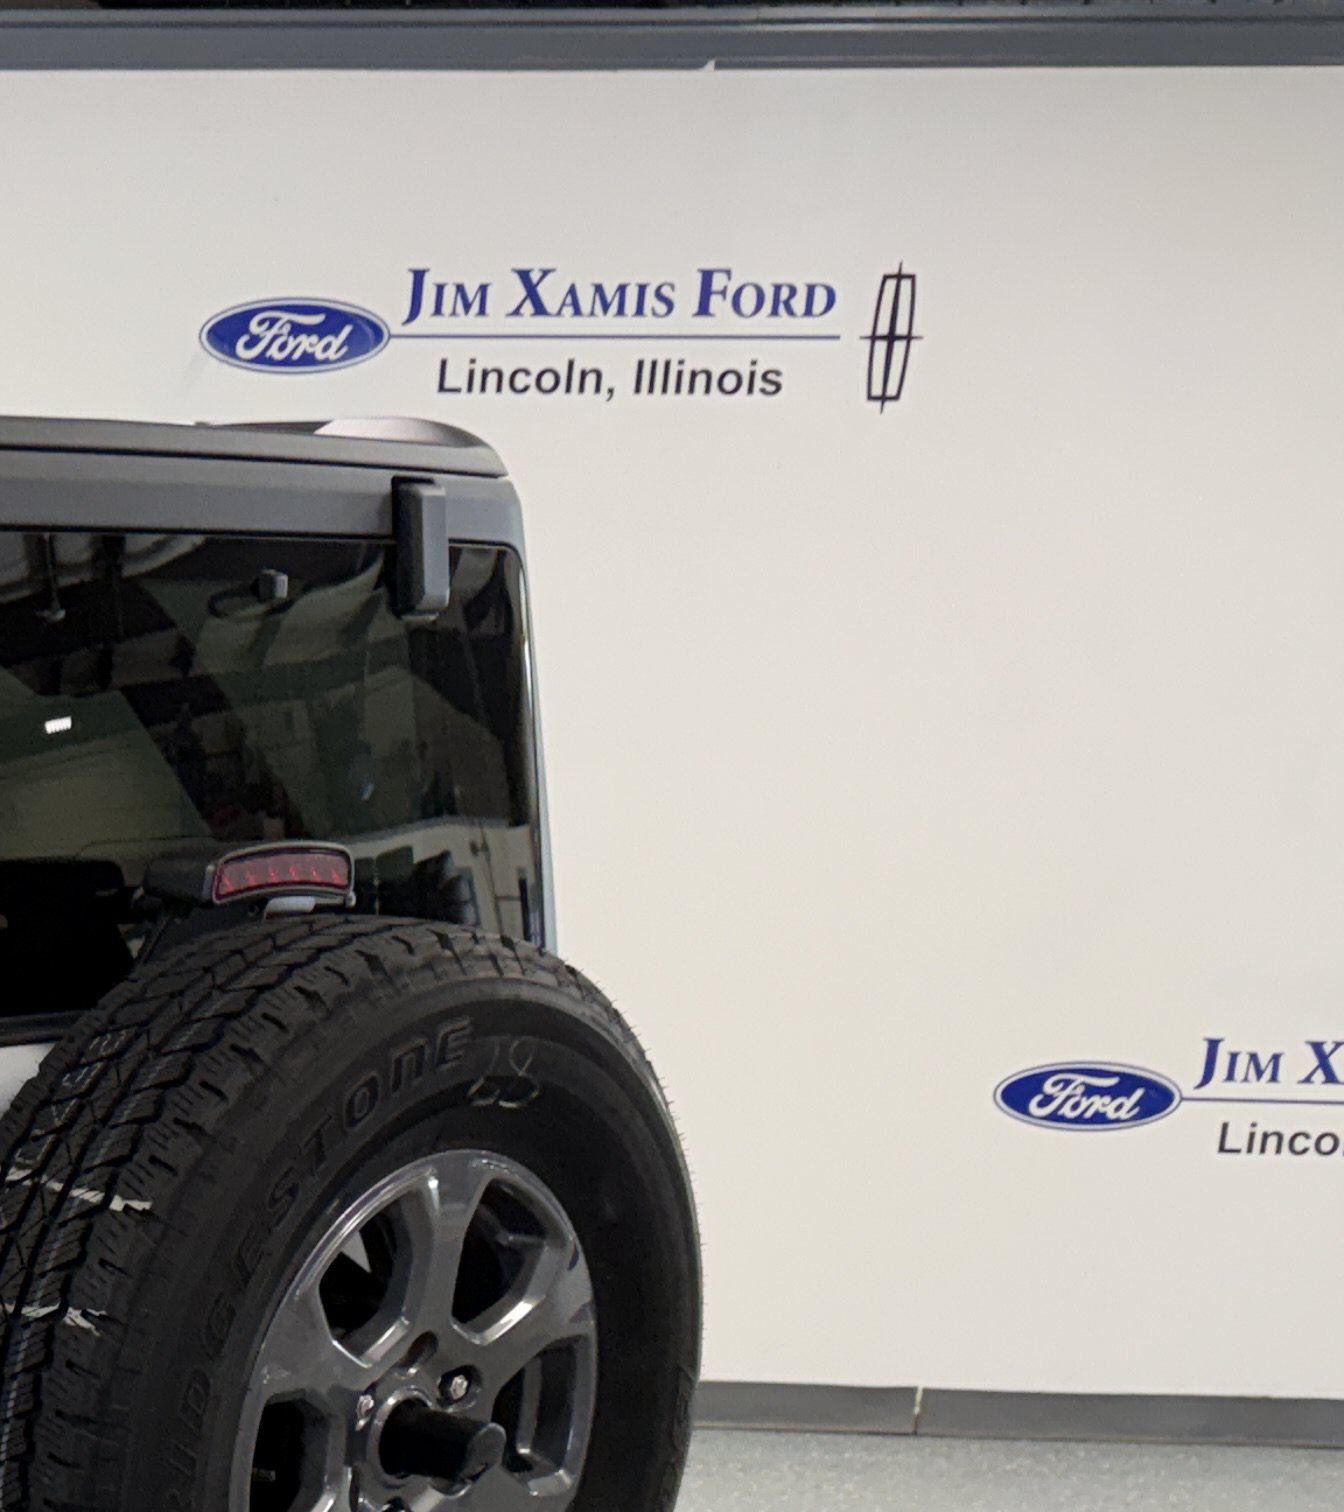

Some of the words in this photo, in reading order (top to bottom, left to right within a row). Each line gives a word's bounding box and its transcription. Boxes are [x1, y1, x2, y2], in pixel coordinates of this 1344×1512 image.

[401, 268, 492, 326] JIM
[505, 268, 675, 319] XAMIS
[693, 268, 837, 319] FORD
[236, 310, 351, 362] Ford
[437, 358, 614, 402] Lincoln,
[632, 358, 784, 396] Illinois
[1194, 1038, 1285, 1090] JIM
[1029, 1073, 1145, 1120] Ford
[1217, 1122, 1344, 1156] Linco
